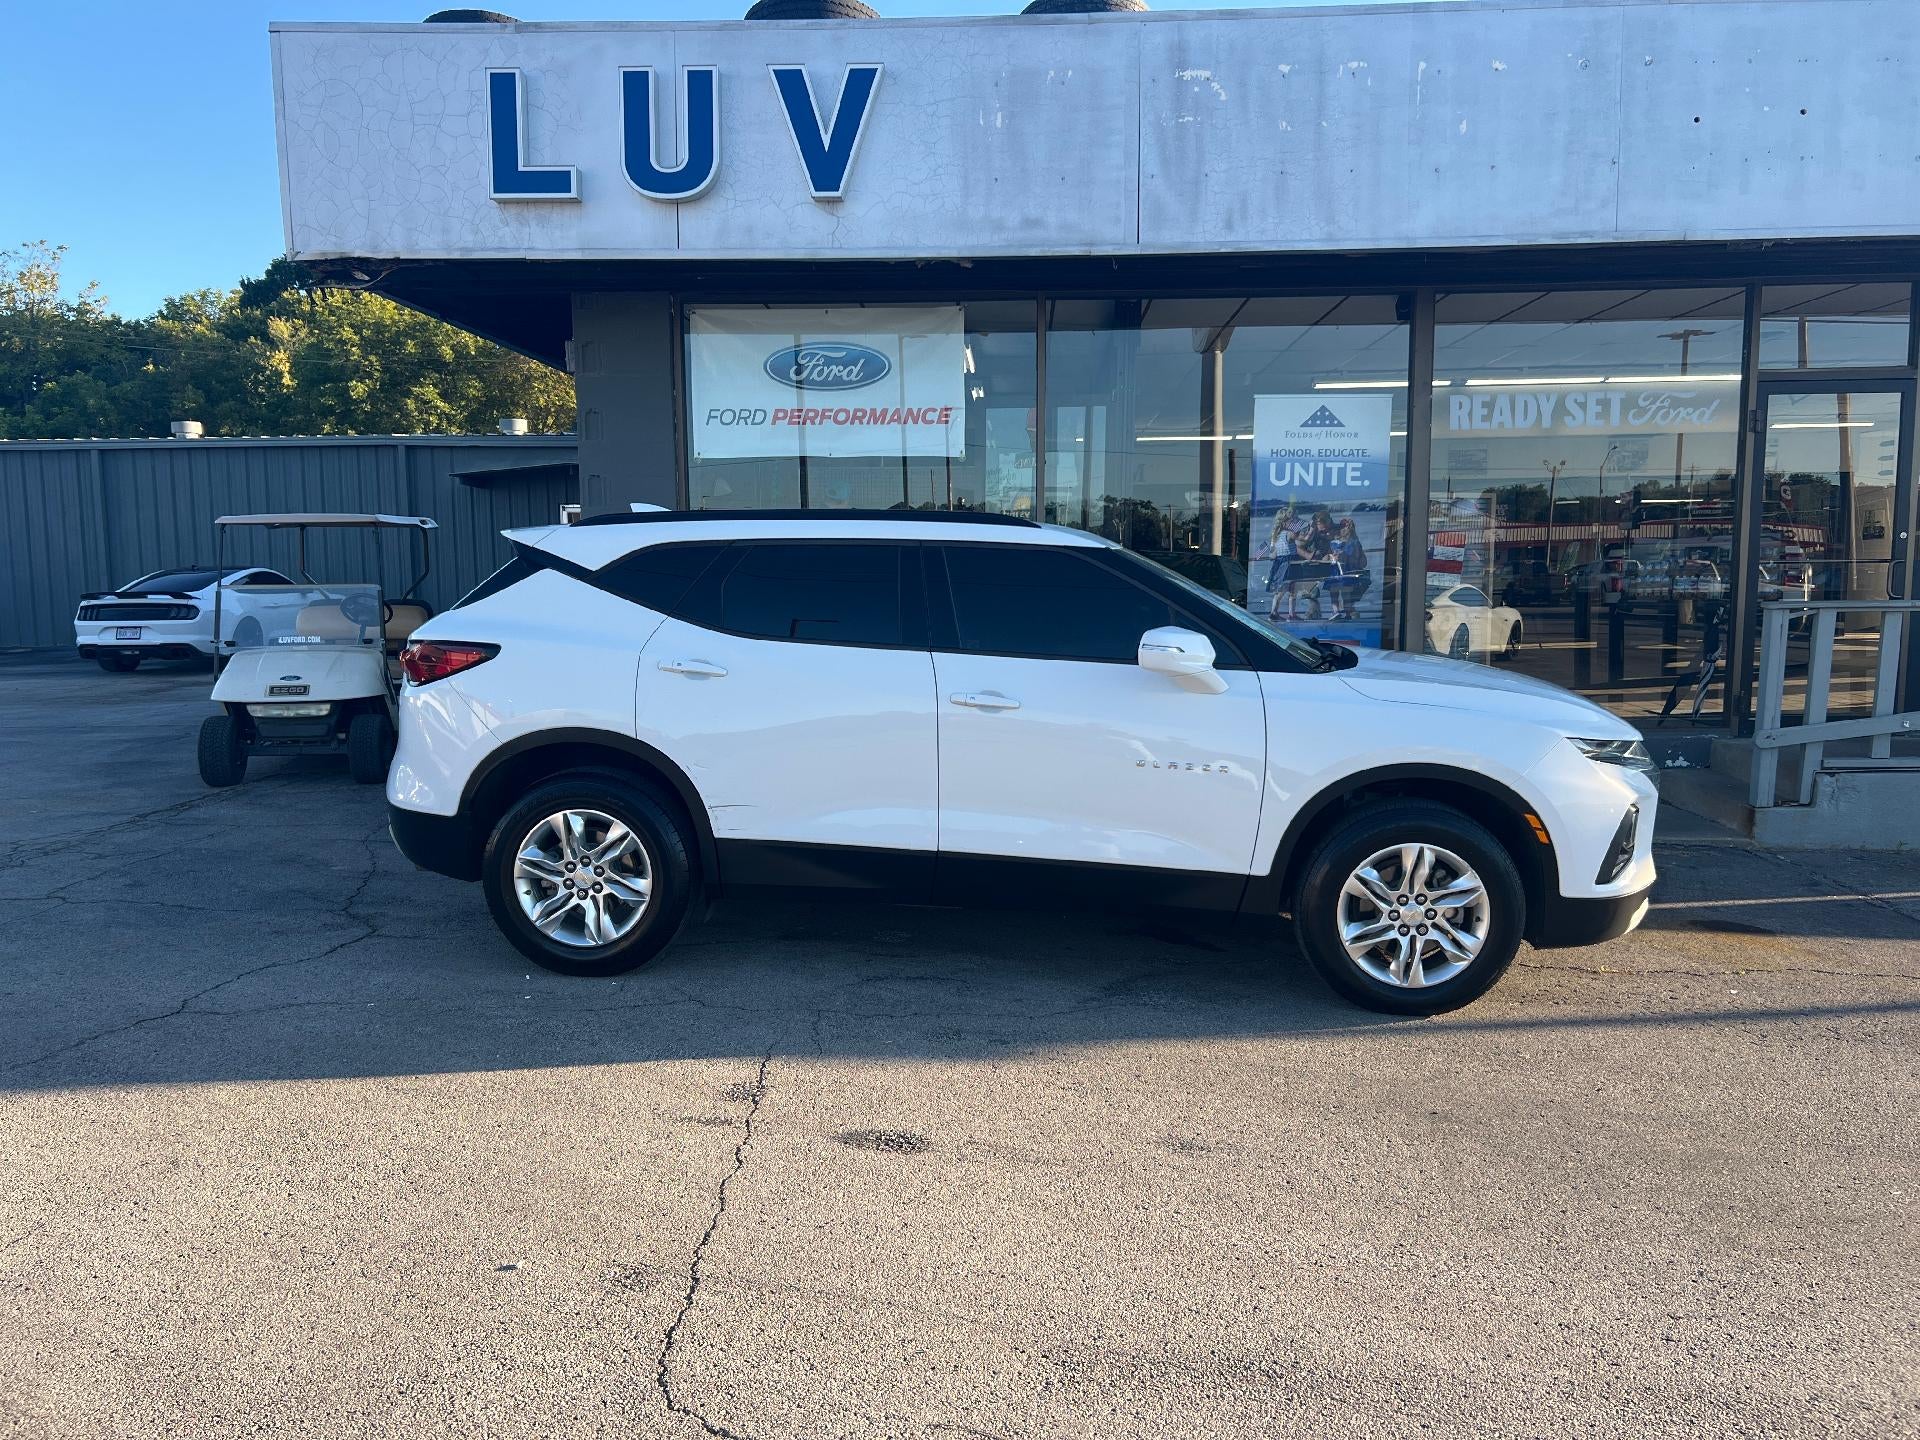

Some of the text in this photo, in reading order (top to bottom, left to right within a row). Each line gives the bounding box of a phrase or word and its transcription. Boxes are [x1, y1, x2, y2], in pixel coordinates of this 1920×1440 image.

[789, 351, 866, 381] Ford
[705, 407, 953, 426] FORD PERFORMANCE
[1449, 391, 1721, 430] READY SET Ford
[1270, 448, 1371, 458] HONOR. EDUCATE.
[1269, 461, 1370, 487] UNITE.
[1135, 759, 1229, 774] BLAZER
